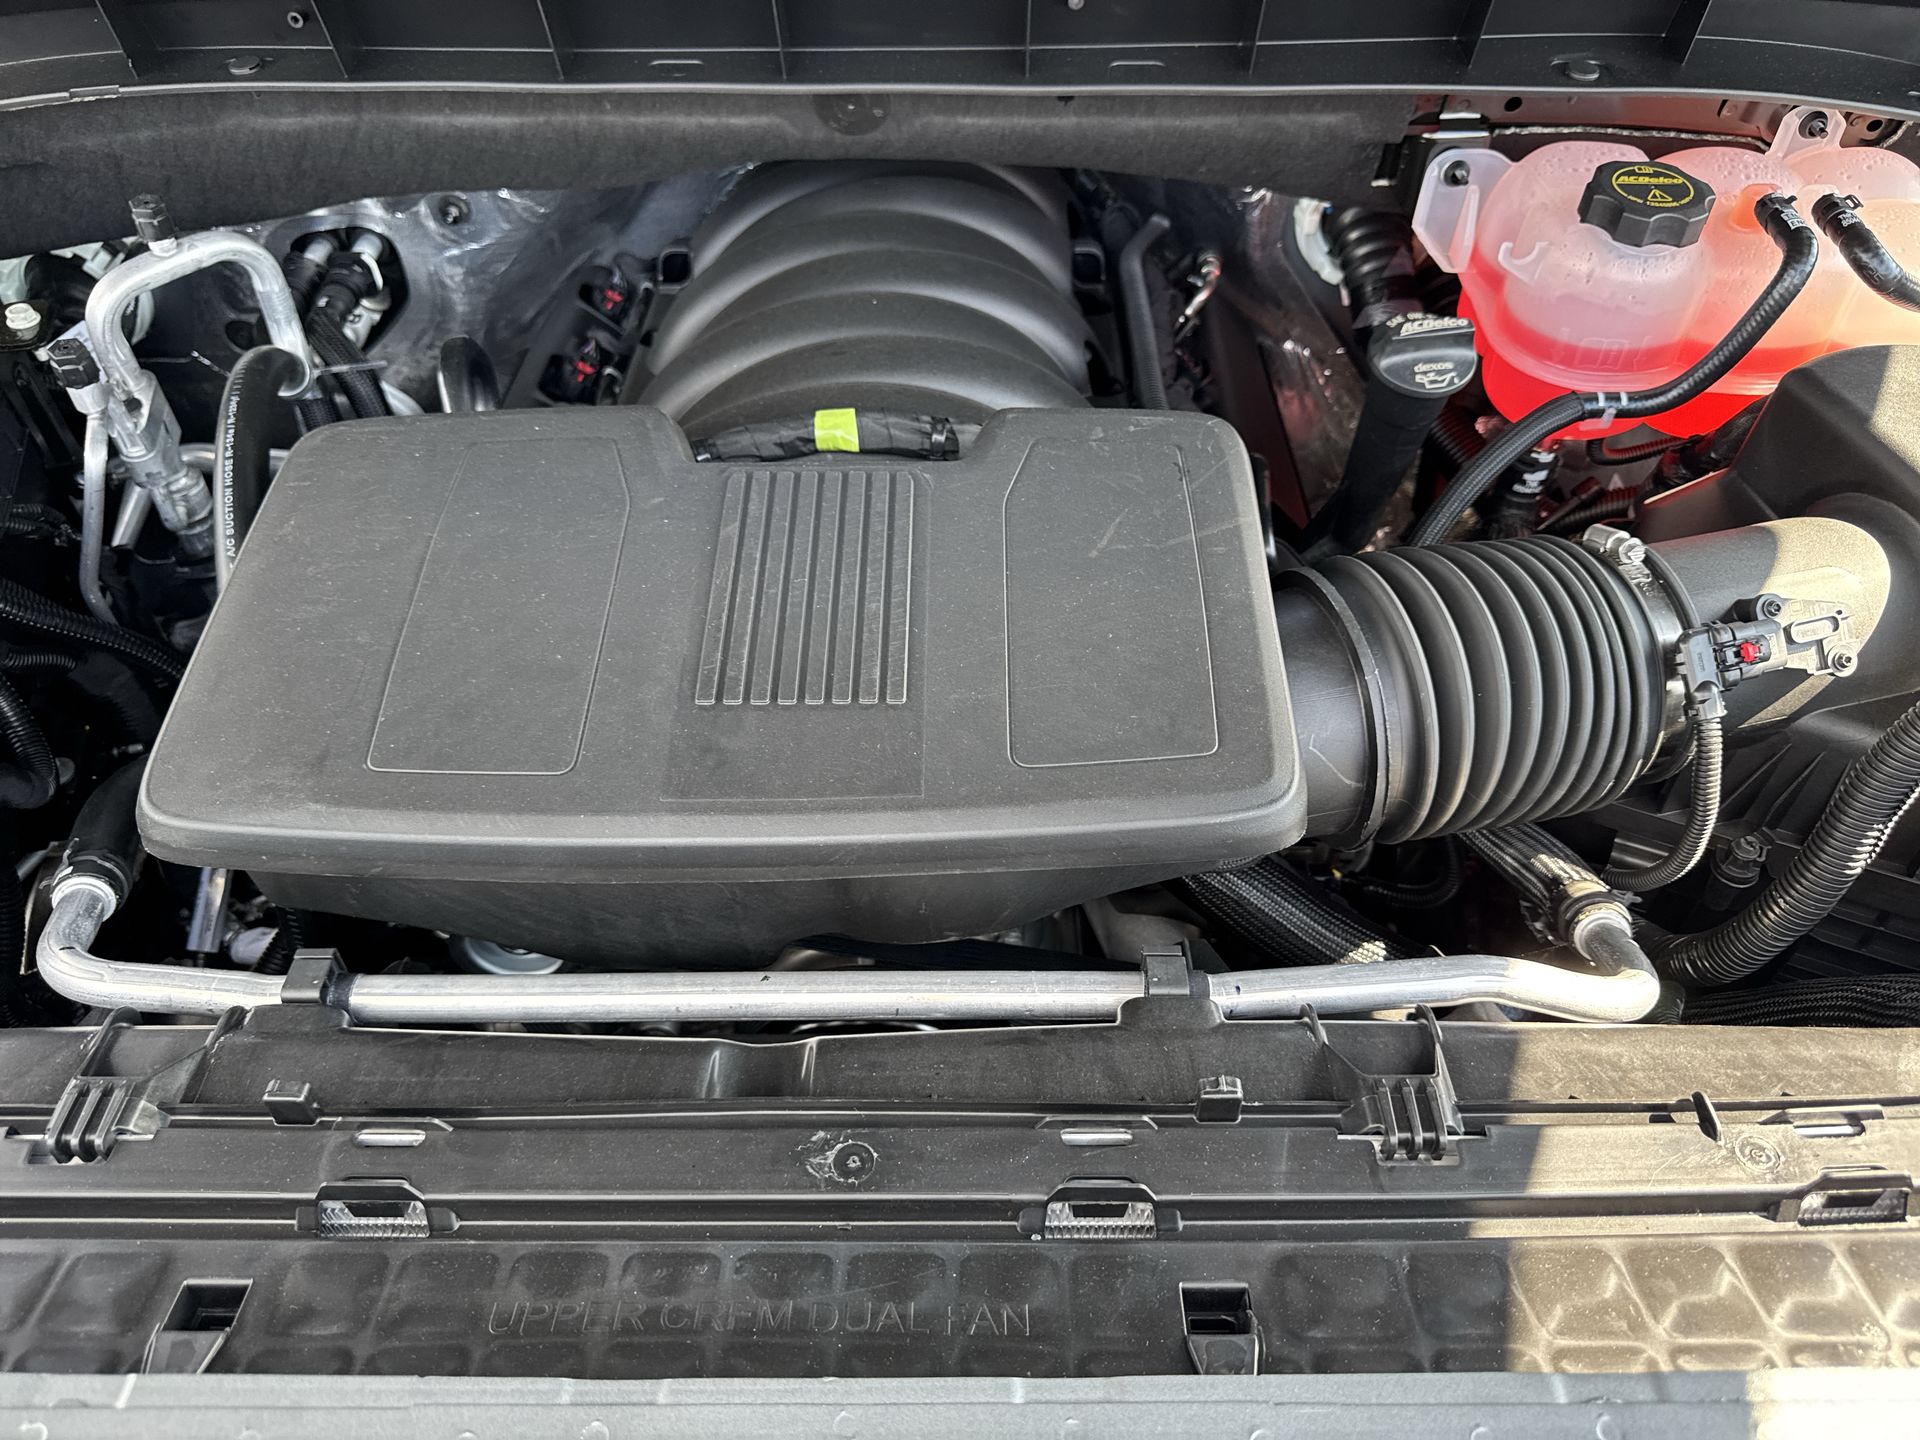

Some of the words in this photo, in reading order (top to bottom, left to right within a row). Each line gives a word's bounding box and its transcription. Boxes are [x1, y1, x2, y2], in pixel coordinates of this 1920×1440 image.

[1616, 175, 1684, 184] ACDelco
[1400, 316, 1469, 336] ACDelco
[1413, 362, 1455, 373] dexos
[224, 458, 233, 486] HOSE
[224, 487, 235, 535] SUCTION
[226, 538, 236, 557] A/C
[488, 1300, 648, 1335] UPPER
[660, 1300, 794, 1333] CRFM
[808, 1301, 930, 1335] DUAL
[946, 1303, 1031, 1337] FAN
